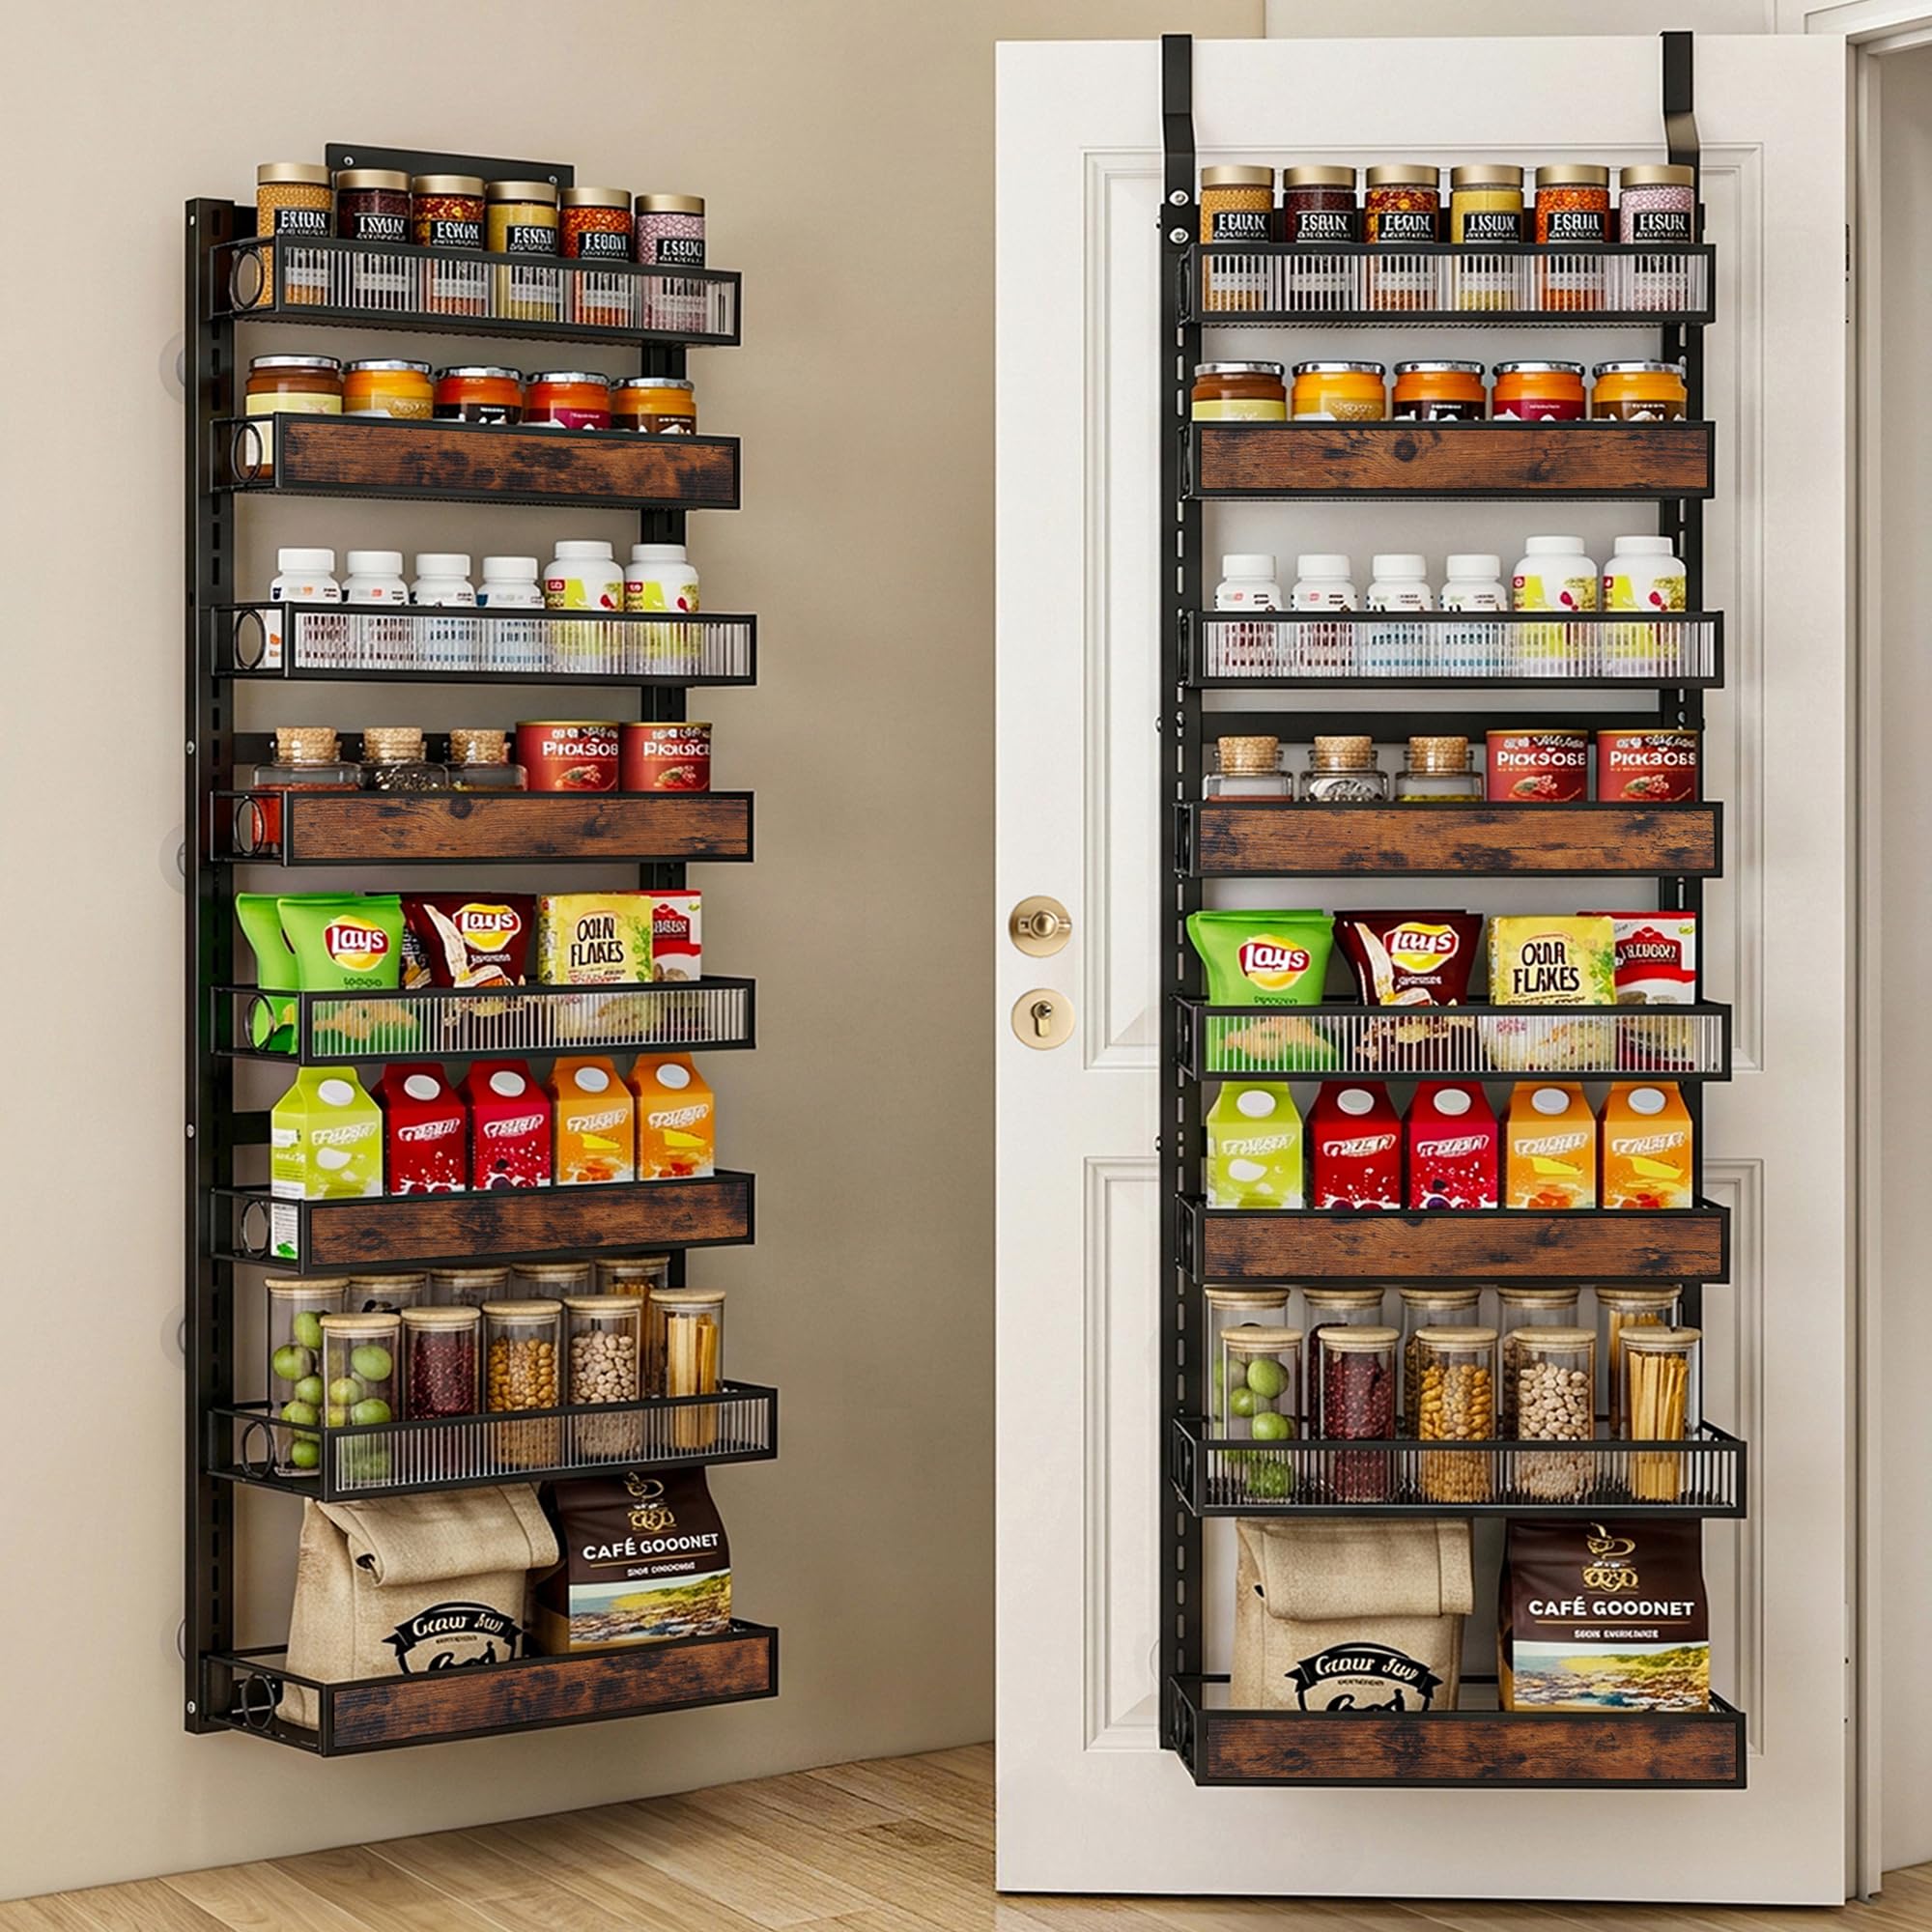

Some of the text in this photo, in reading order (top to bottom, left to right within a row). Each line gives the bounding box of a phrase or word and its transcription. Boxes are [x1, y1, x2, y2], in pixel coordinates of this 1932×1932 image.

[461, 912, 515, 932] Lays
[331, 927, 384, 954] Lays
[1245, 944, 1306, 973] Lays
[582, 1537, 638, 1561] CAFÉ
[1528, 1596, 1695, 1616] CAFÉ GOODNET
